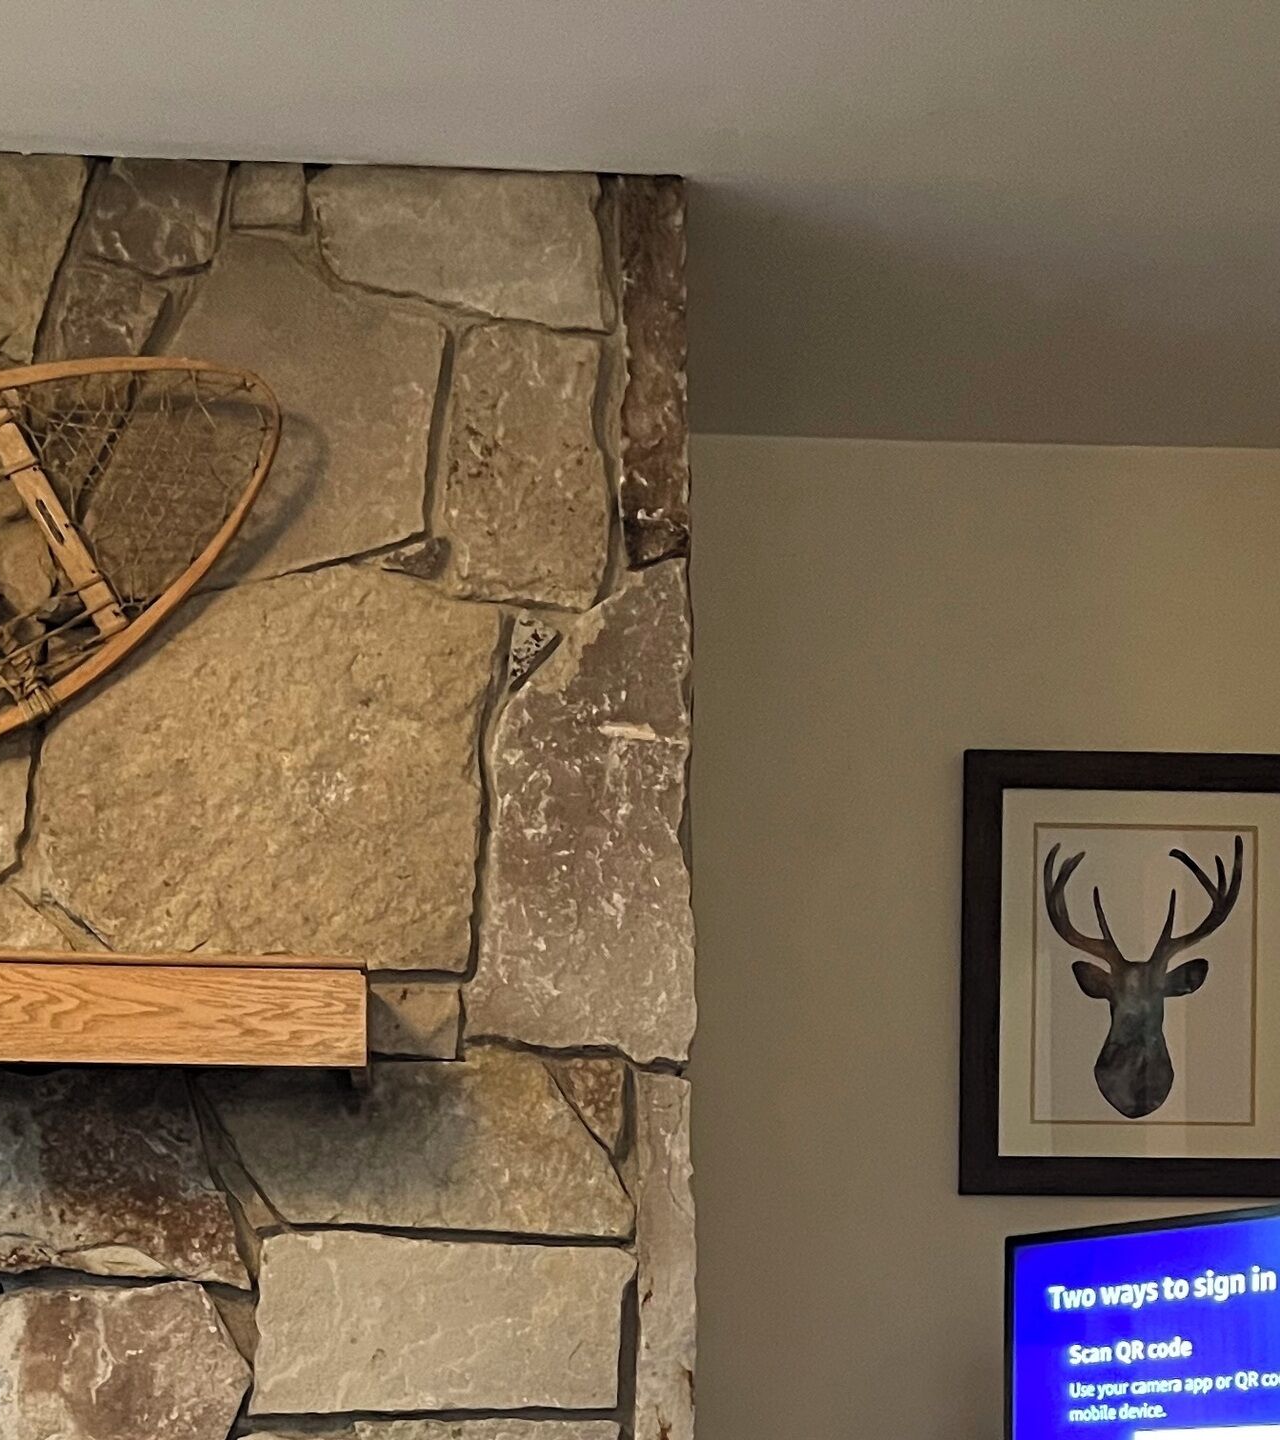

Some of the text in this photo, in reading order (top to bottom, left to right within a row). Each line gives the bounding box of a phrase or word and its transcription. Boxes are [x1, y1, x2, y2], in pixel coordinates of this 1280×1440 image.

[1048, 1265, 1277, 1309] Two ways to sign in
[1069, 1336, 1192, 1365] Scan QR code
[1070, 1382, 1095, 1399] Use
[1097, 1382, 1129, 1400] your
[1131, 1378, 1182, 1395] camera
[1185, 1376, 1213, 1394] app
[1215, 1375, 1233, 1389] or
[1235, 1371, 1259, 1391] QR
[1069, 1403, 1167, 1422] mobile device.
